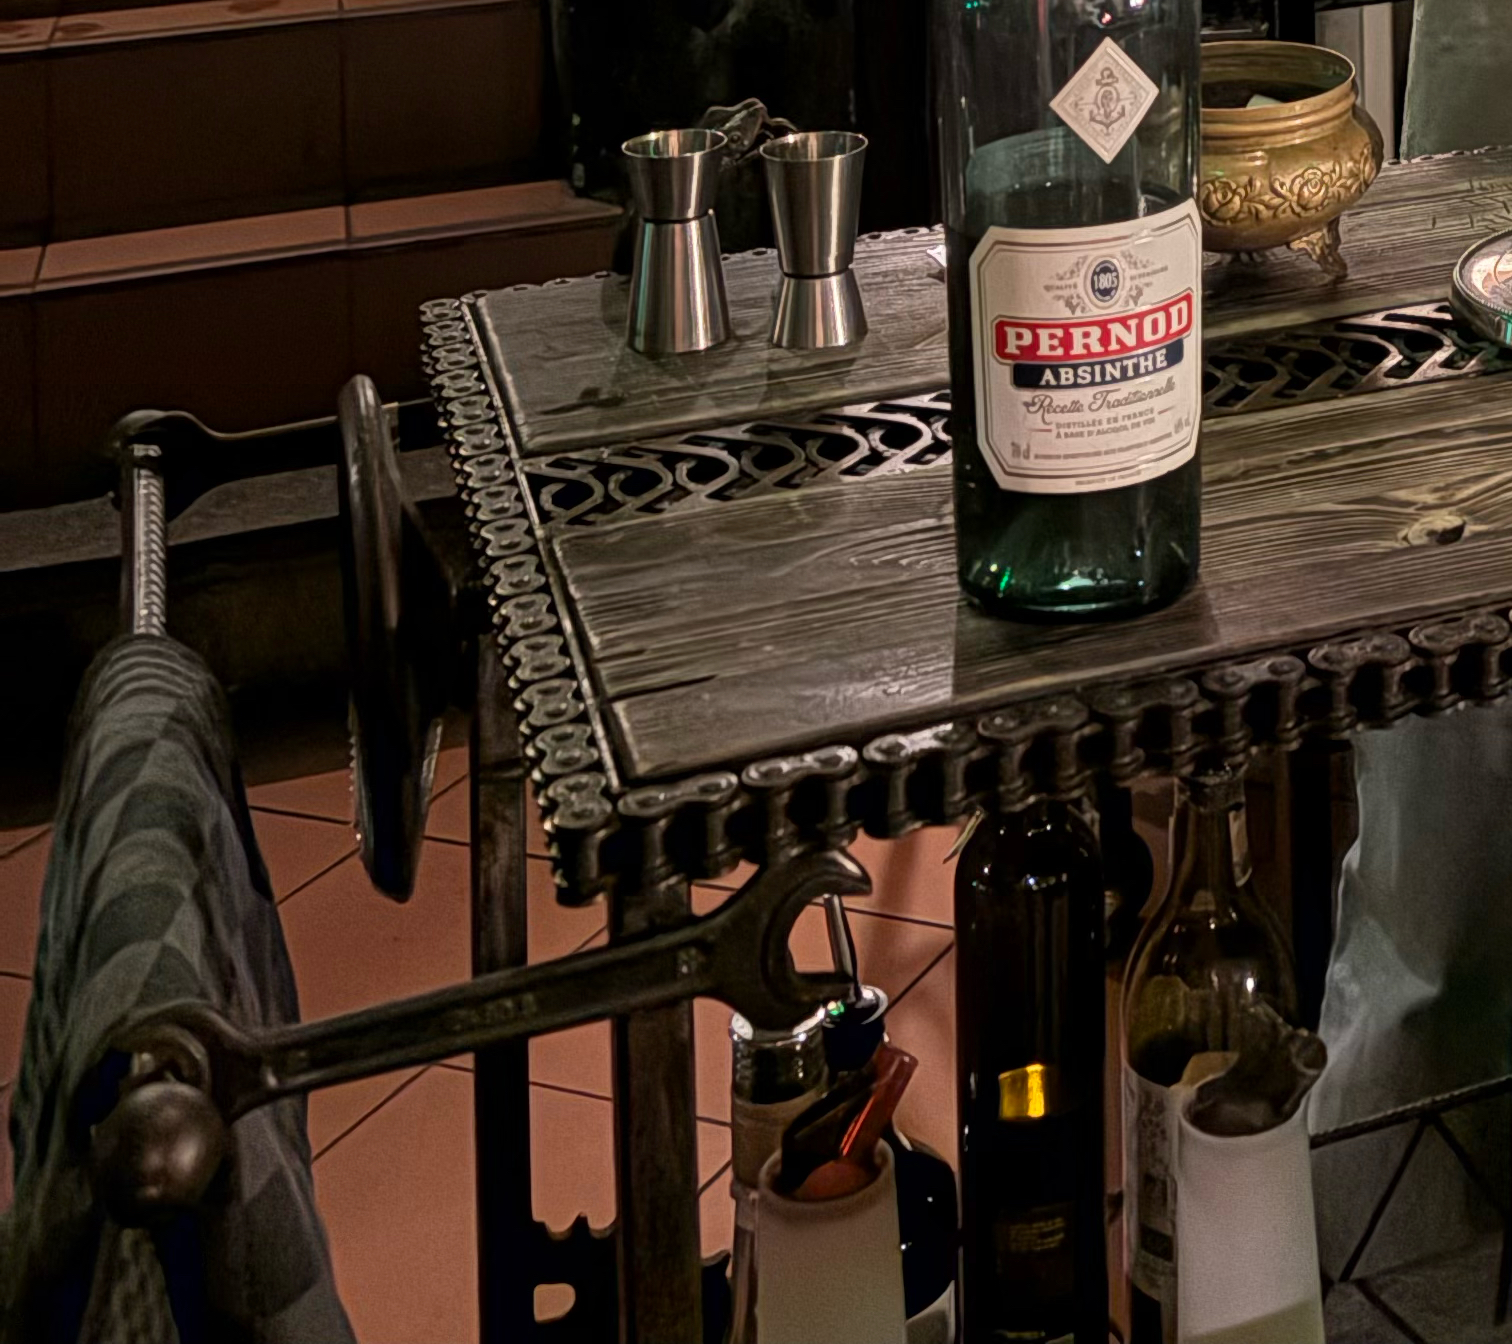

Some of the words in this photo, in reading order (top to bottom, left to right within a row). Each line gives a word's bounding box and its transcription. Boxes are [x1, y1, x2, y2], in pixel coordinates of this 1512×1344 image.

[1093, 272, 1119, 290] 1805
[1003, 298, 1189, 356] PERNOD
[1038, 348, 1168, 387] ABSINTHE
